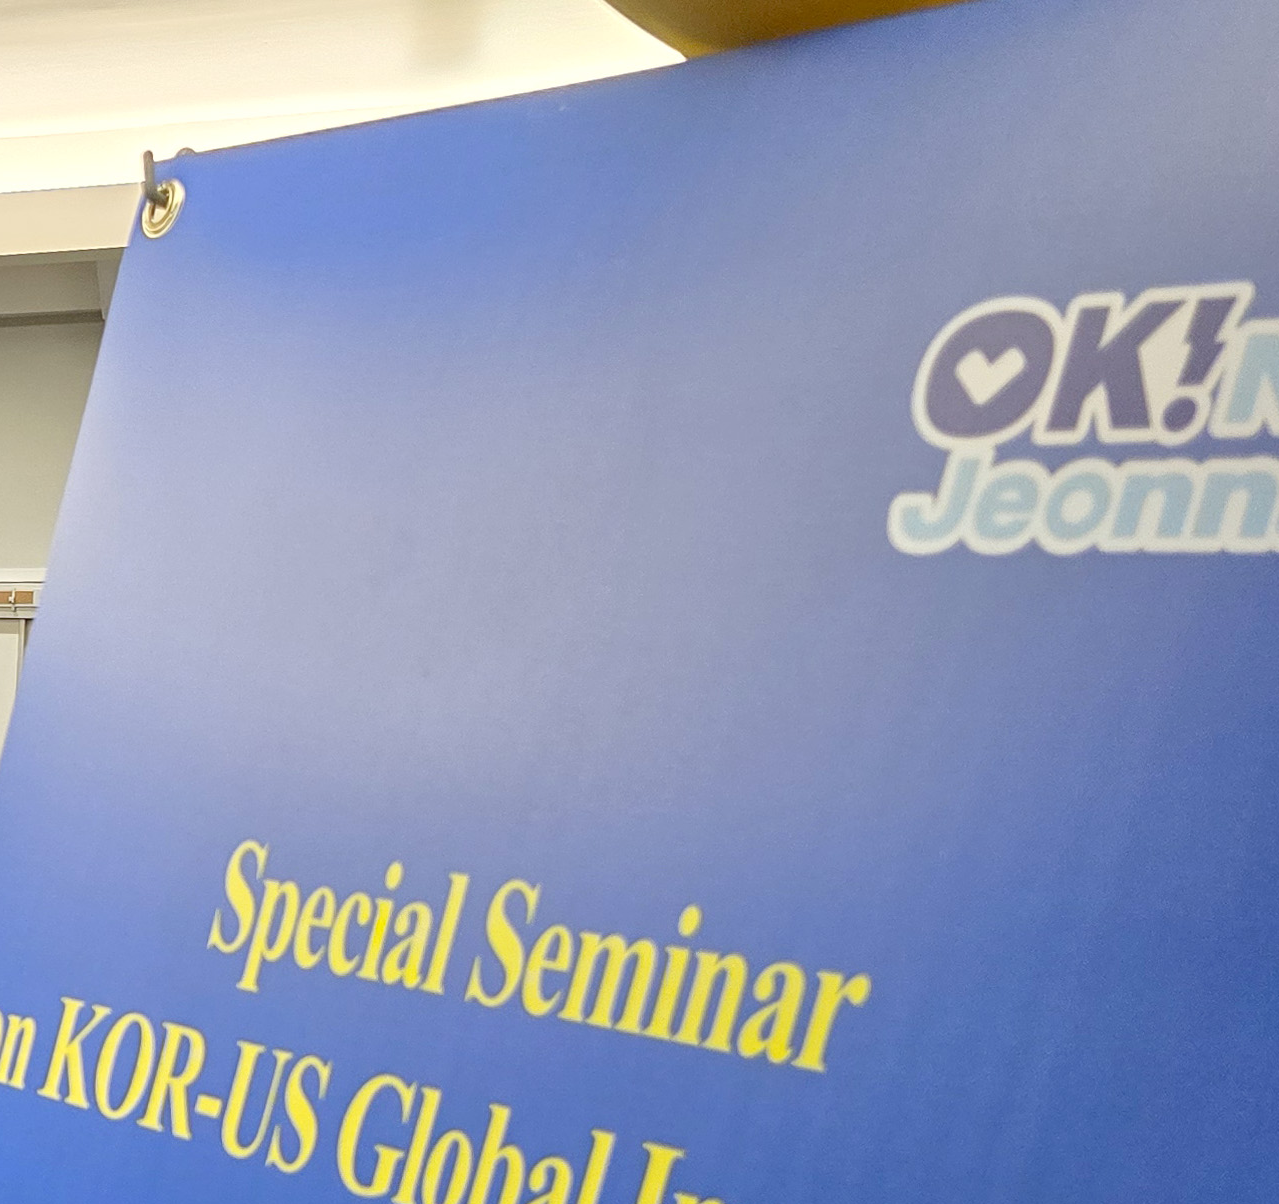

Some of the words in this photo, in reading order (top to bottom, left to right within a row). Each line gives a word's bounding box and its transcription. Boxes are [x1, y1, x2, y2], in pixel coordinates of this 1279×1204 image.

[891, 445, 1279, 552] Jeonn
[207, 839, 469, 993] Special
[465, 879, 871, 1072] Seminar
[39, 996, 332, 1173] KOR-US
